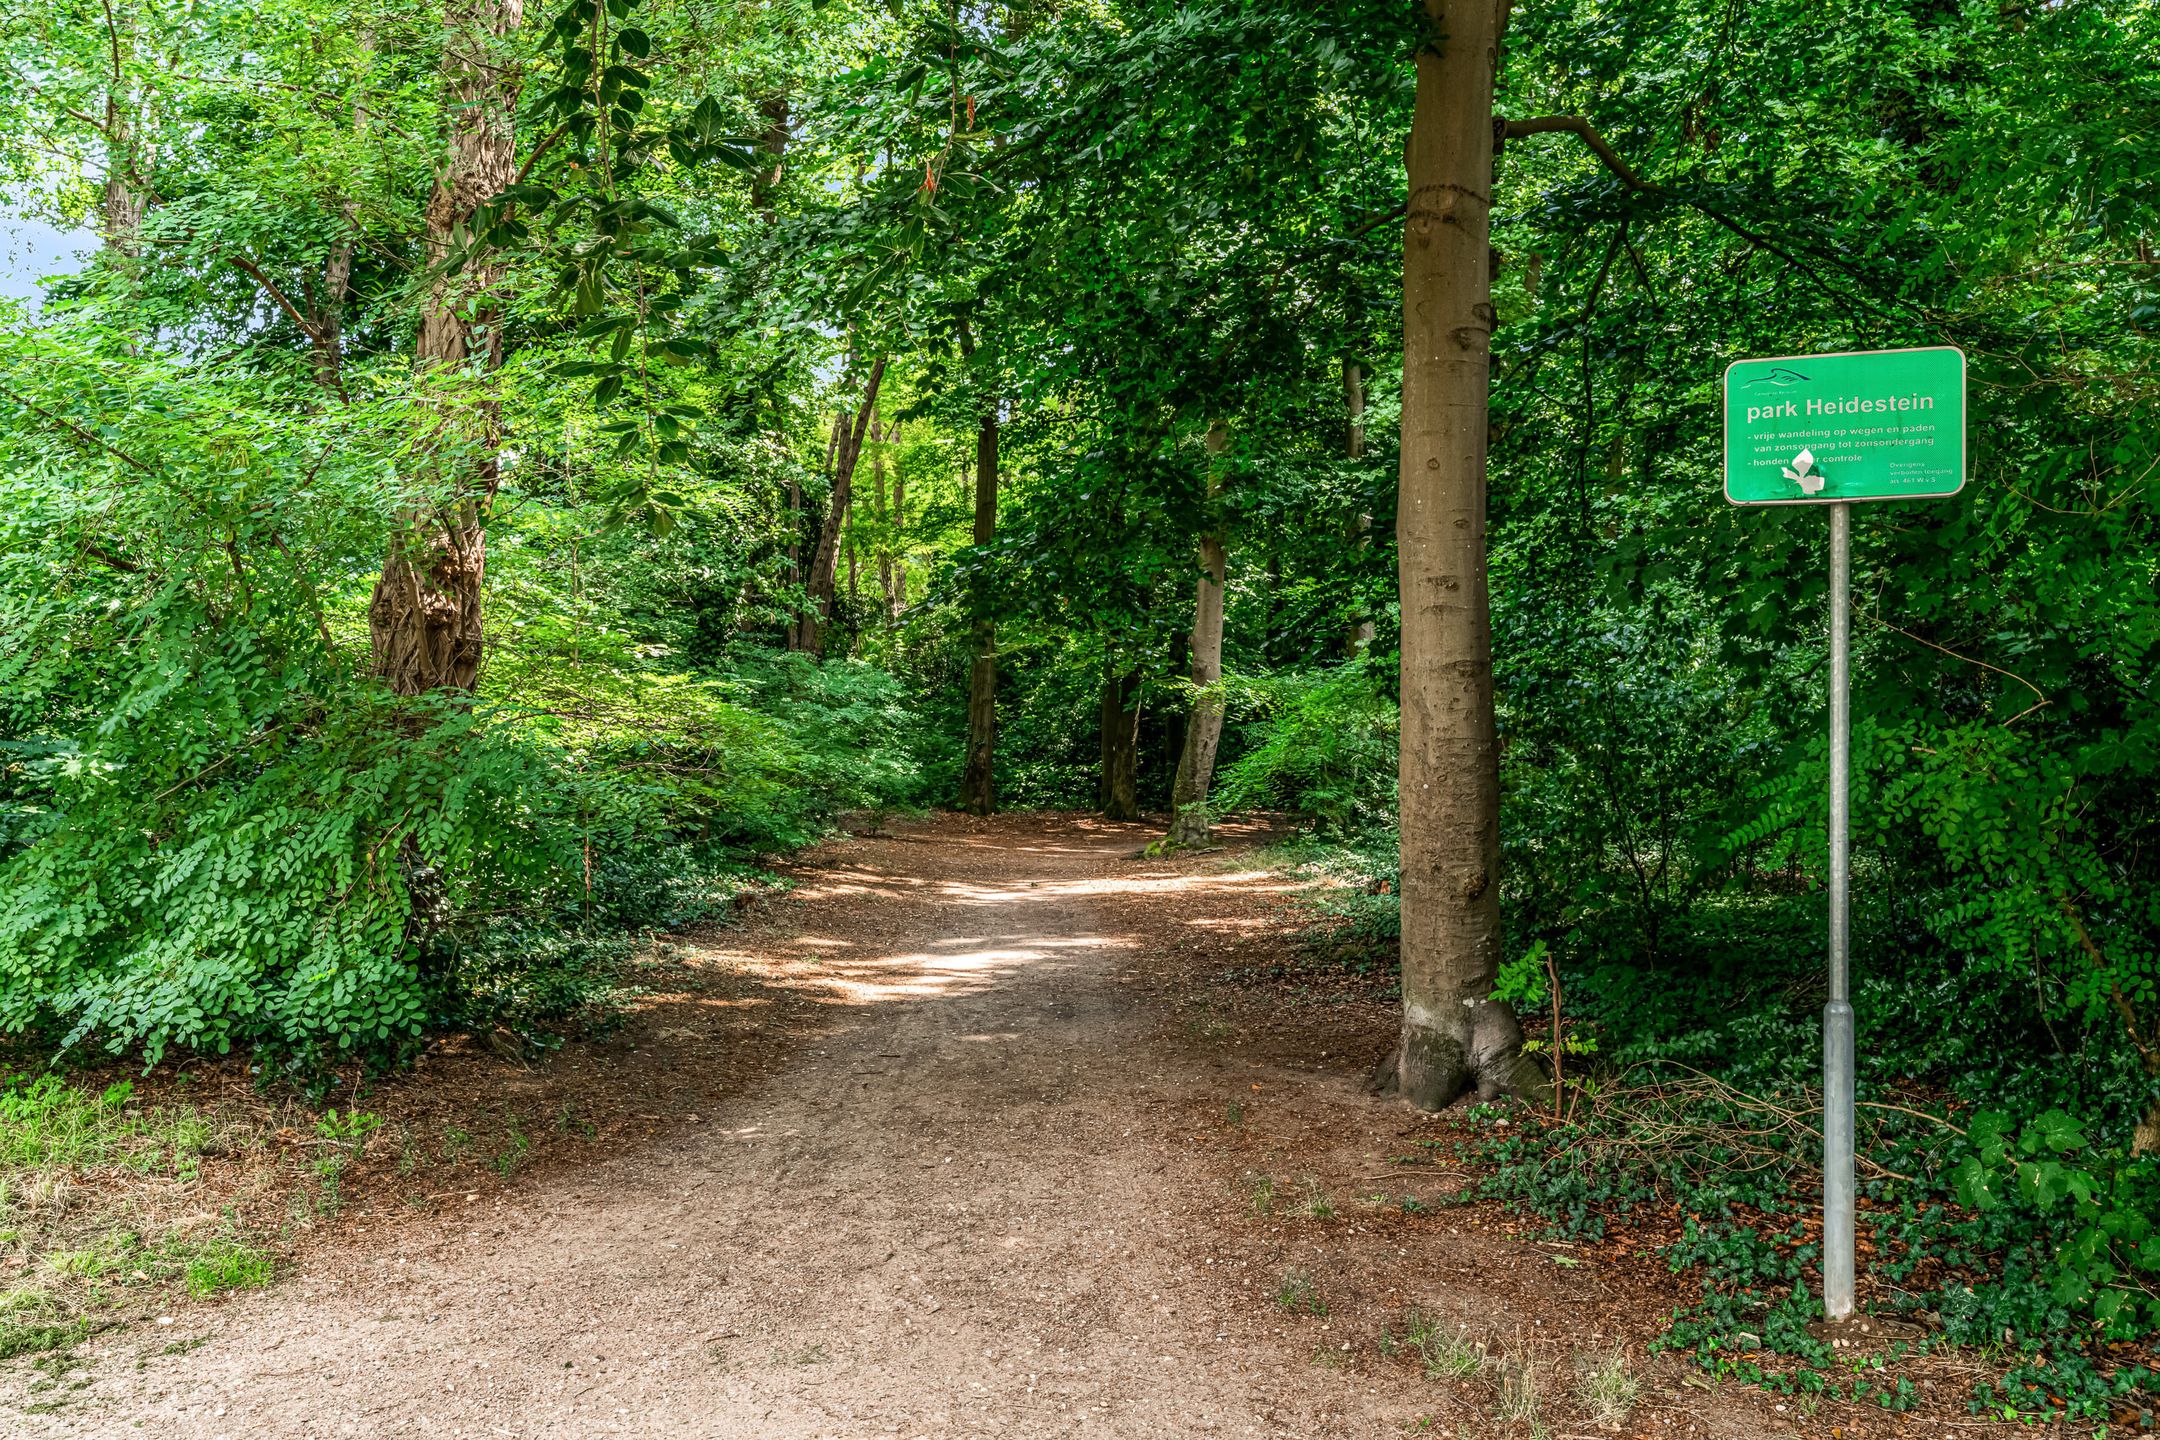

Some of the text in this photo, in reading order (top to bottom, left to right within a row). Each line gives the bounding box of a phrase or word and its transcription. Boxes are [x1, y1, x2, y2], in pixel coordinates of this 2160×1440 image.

[1747, 393, 1934, 424] park Heidestein
[1754, 423, 1935, 442] vrije wandeling op wegen en paden
[1754, 445, 1772, 453] van
[1838, 439, 1852, 448] tot
[1854, 437, 1935, 448] zonsondergang
[1753, 456, 1789, 467] honden
[1822, 454, 1862, 463] controle
